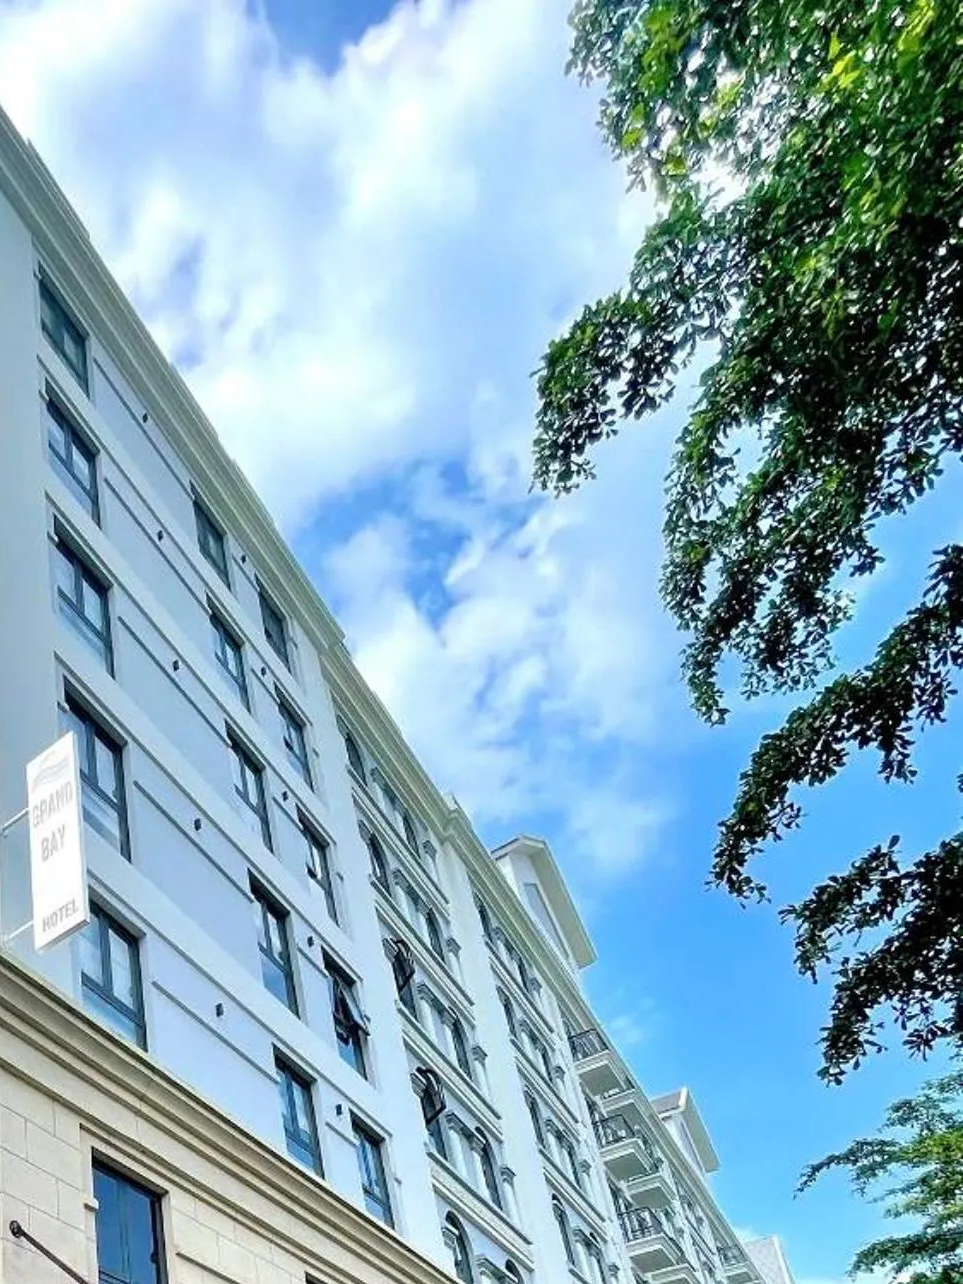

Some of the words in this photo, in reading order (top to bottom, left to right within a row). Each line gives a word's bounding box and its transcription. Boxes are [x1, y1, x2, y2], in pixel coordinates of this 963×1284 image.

[32, 780, 73, 829] GRAND
[40, 823, 67, 862] BAY
[42, 898, 79, 933] HOTEL
